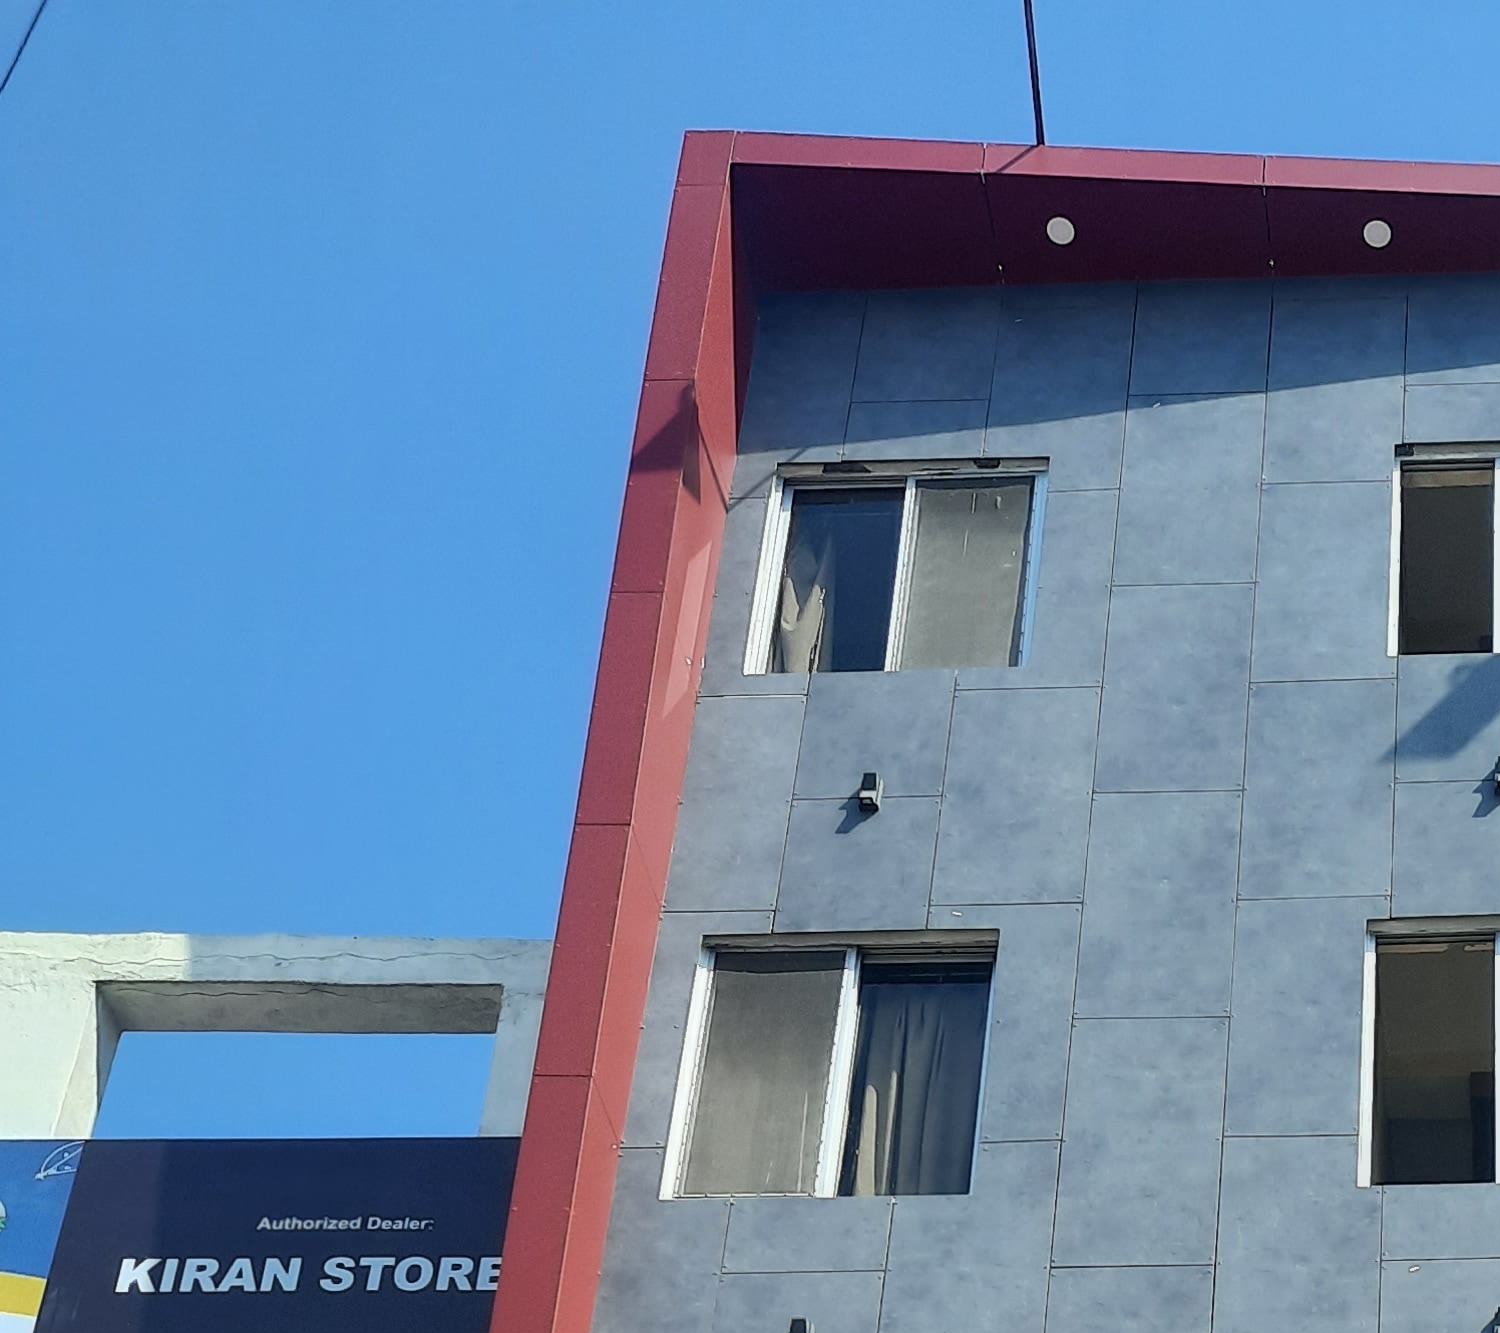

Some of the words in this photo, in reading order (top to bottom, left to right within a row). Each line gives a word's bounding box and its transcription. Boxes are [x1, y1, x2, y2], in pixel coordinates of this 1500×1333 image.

[256, 1216, 362, 1232] Authorized
[366, 1216, 435, 1232] Dealer:
[114, 1257, 302, 1293] KIRAN
[319, 1256, 503, 1292] STORE
